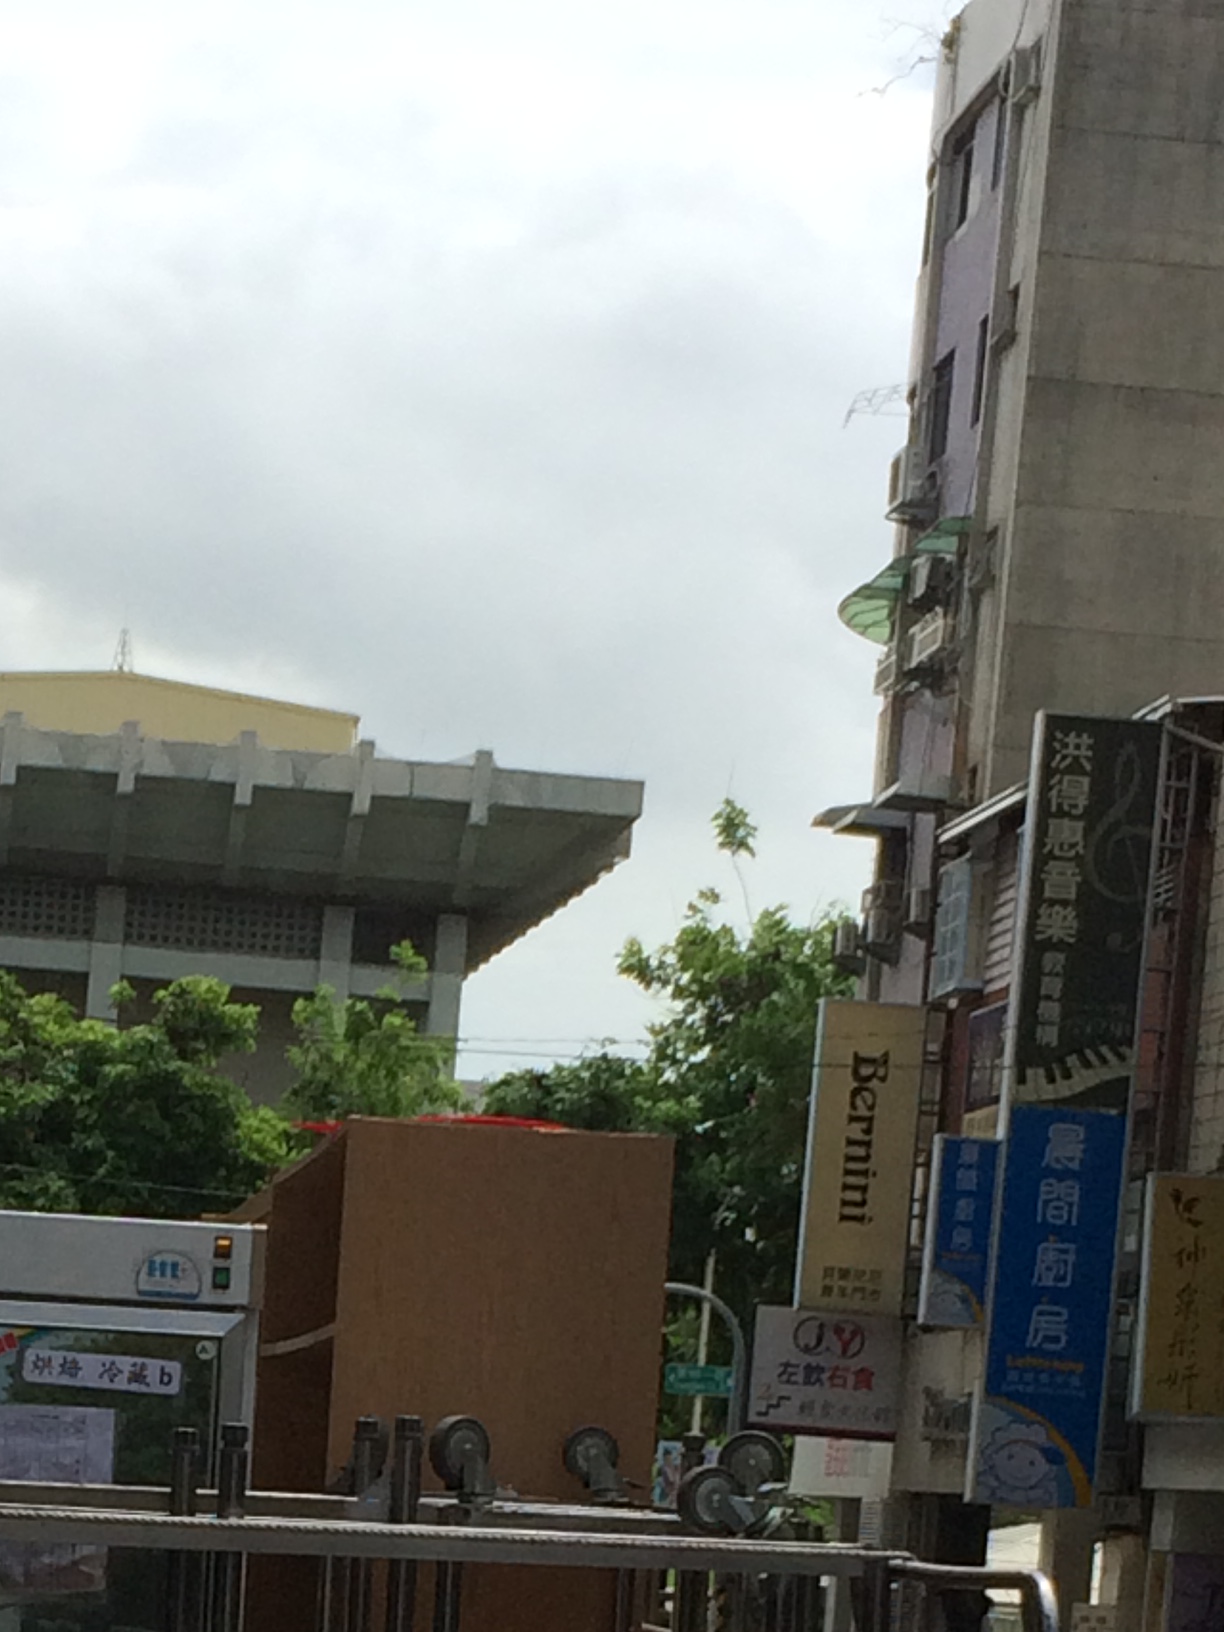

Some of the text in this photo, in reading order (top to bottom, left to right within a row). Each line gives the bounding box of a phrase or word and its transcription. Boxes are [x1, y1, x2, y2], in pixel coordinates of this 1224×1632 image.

[838, 1049, 890, 1228] Bernini
[777, 1359, 874, 1392] 左飲右食
